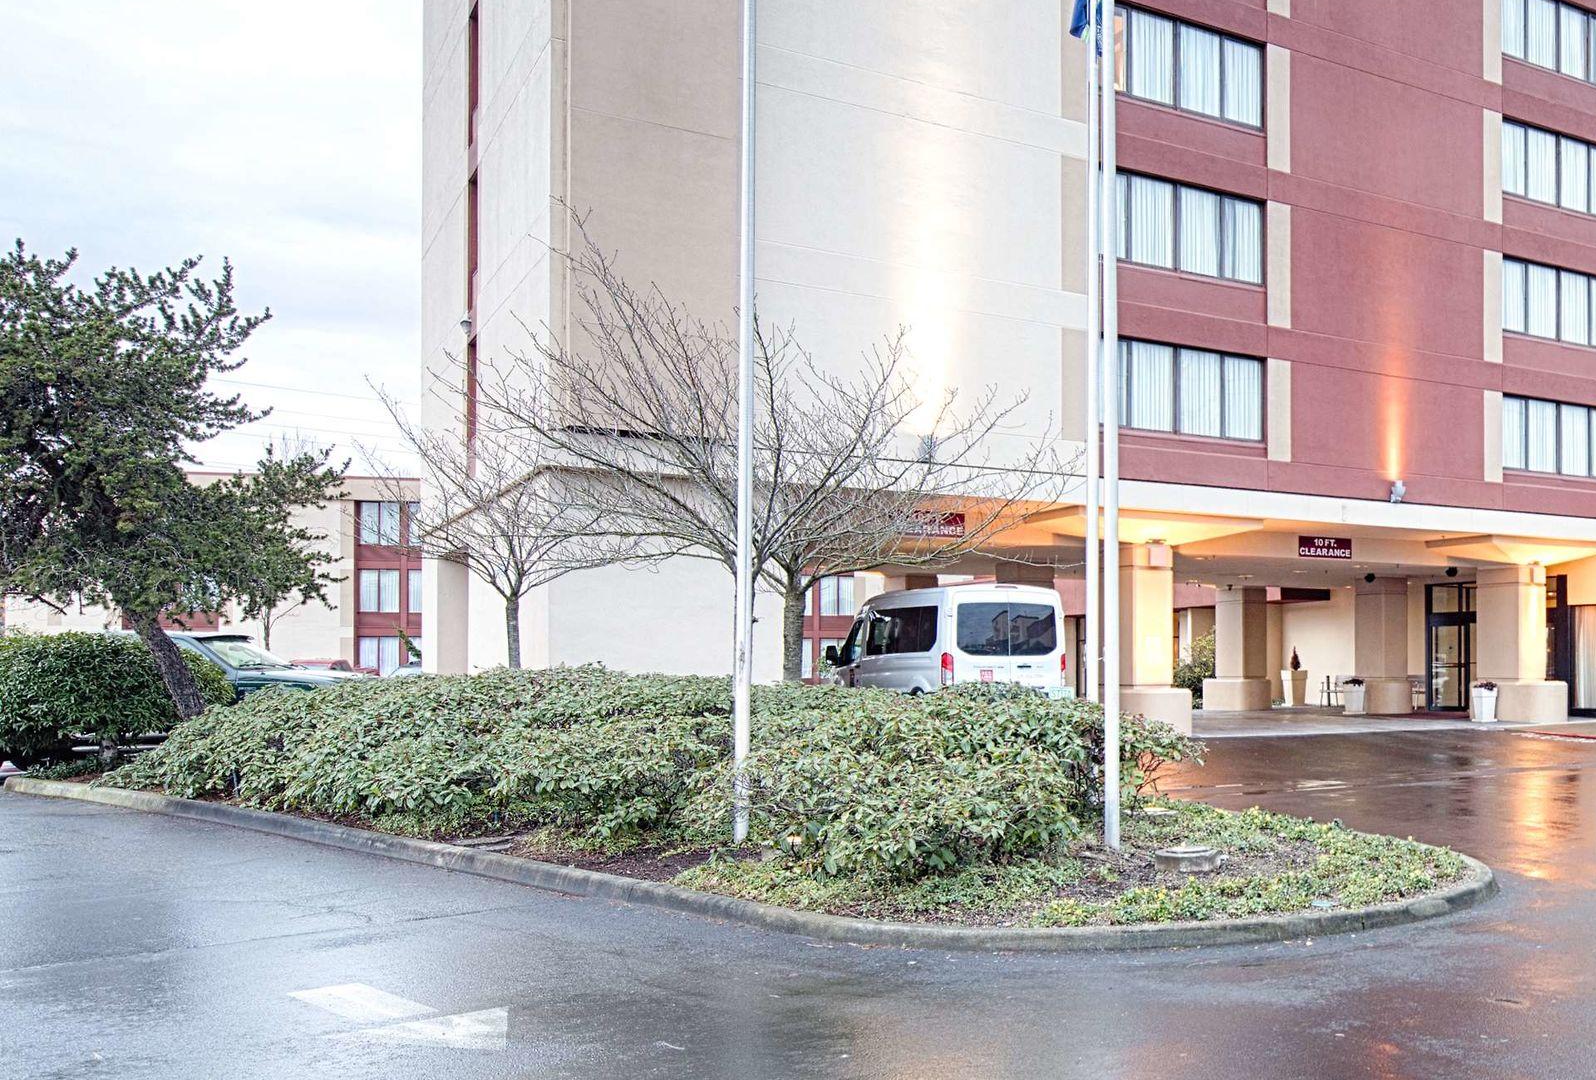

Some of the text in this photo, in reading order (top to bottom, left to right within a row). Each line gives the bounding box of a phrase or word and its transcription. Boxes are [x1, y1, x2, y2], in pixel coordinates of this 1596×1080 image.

[1314, 538, 1337, 547] 10 FT.
[1299, 547, 1351, 557] CLEARANCE
